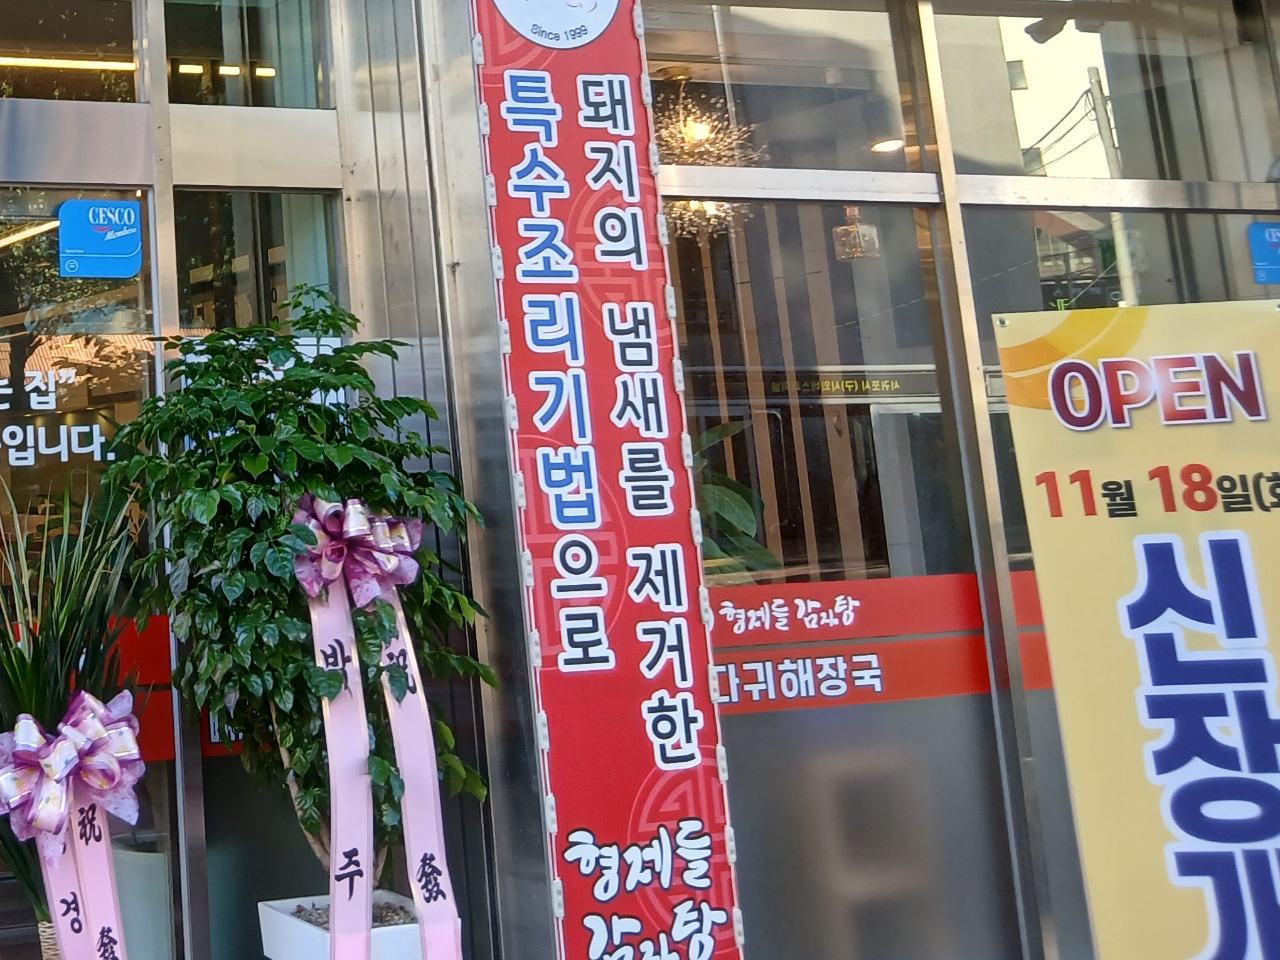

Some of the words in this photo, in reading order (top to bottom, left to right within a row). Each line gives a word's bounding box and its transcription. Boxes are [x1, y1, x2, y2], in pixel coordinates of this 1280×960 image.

[530, 23, 561, 41] Since
[564, 24, 588, 41] 1999
[576, 73, 649, 270] 돼지의
[88, 206, 136, 226] CESCO
[602, 301, 674, 517] 냄새를
[1047, 350, 1268, 431] OPEN
[1035, 469, 1138, 518] 11월
[720, 599, 789, 634] 형제들
[794, 595, 860, 630] 감자탕
[627, 543, 703, 771] 제거한
[563, 817, 714, 903] 형제들
